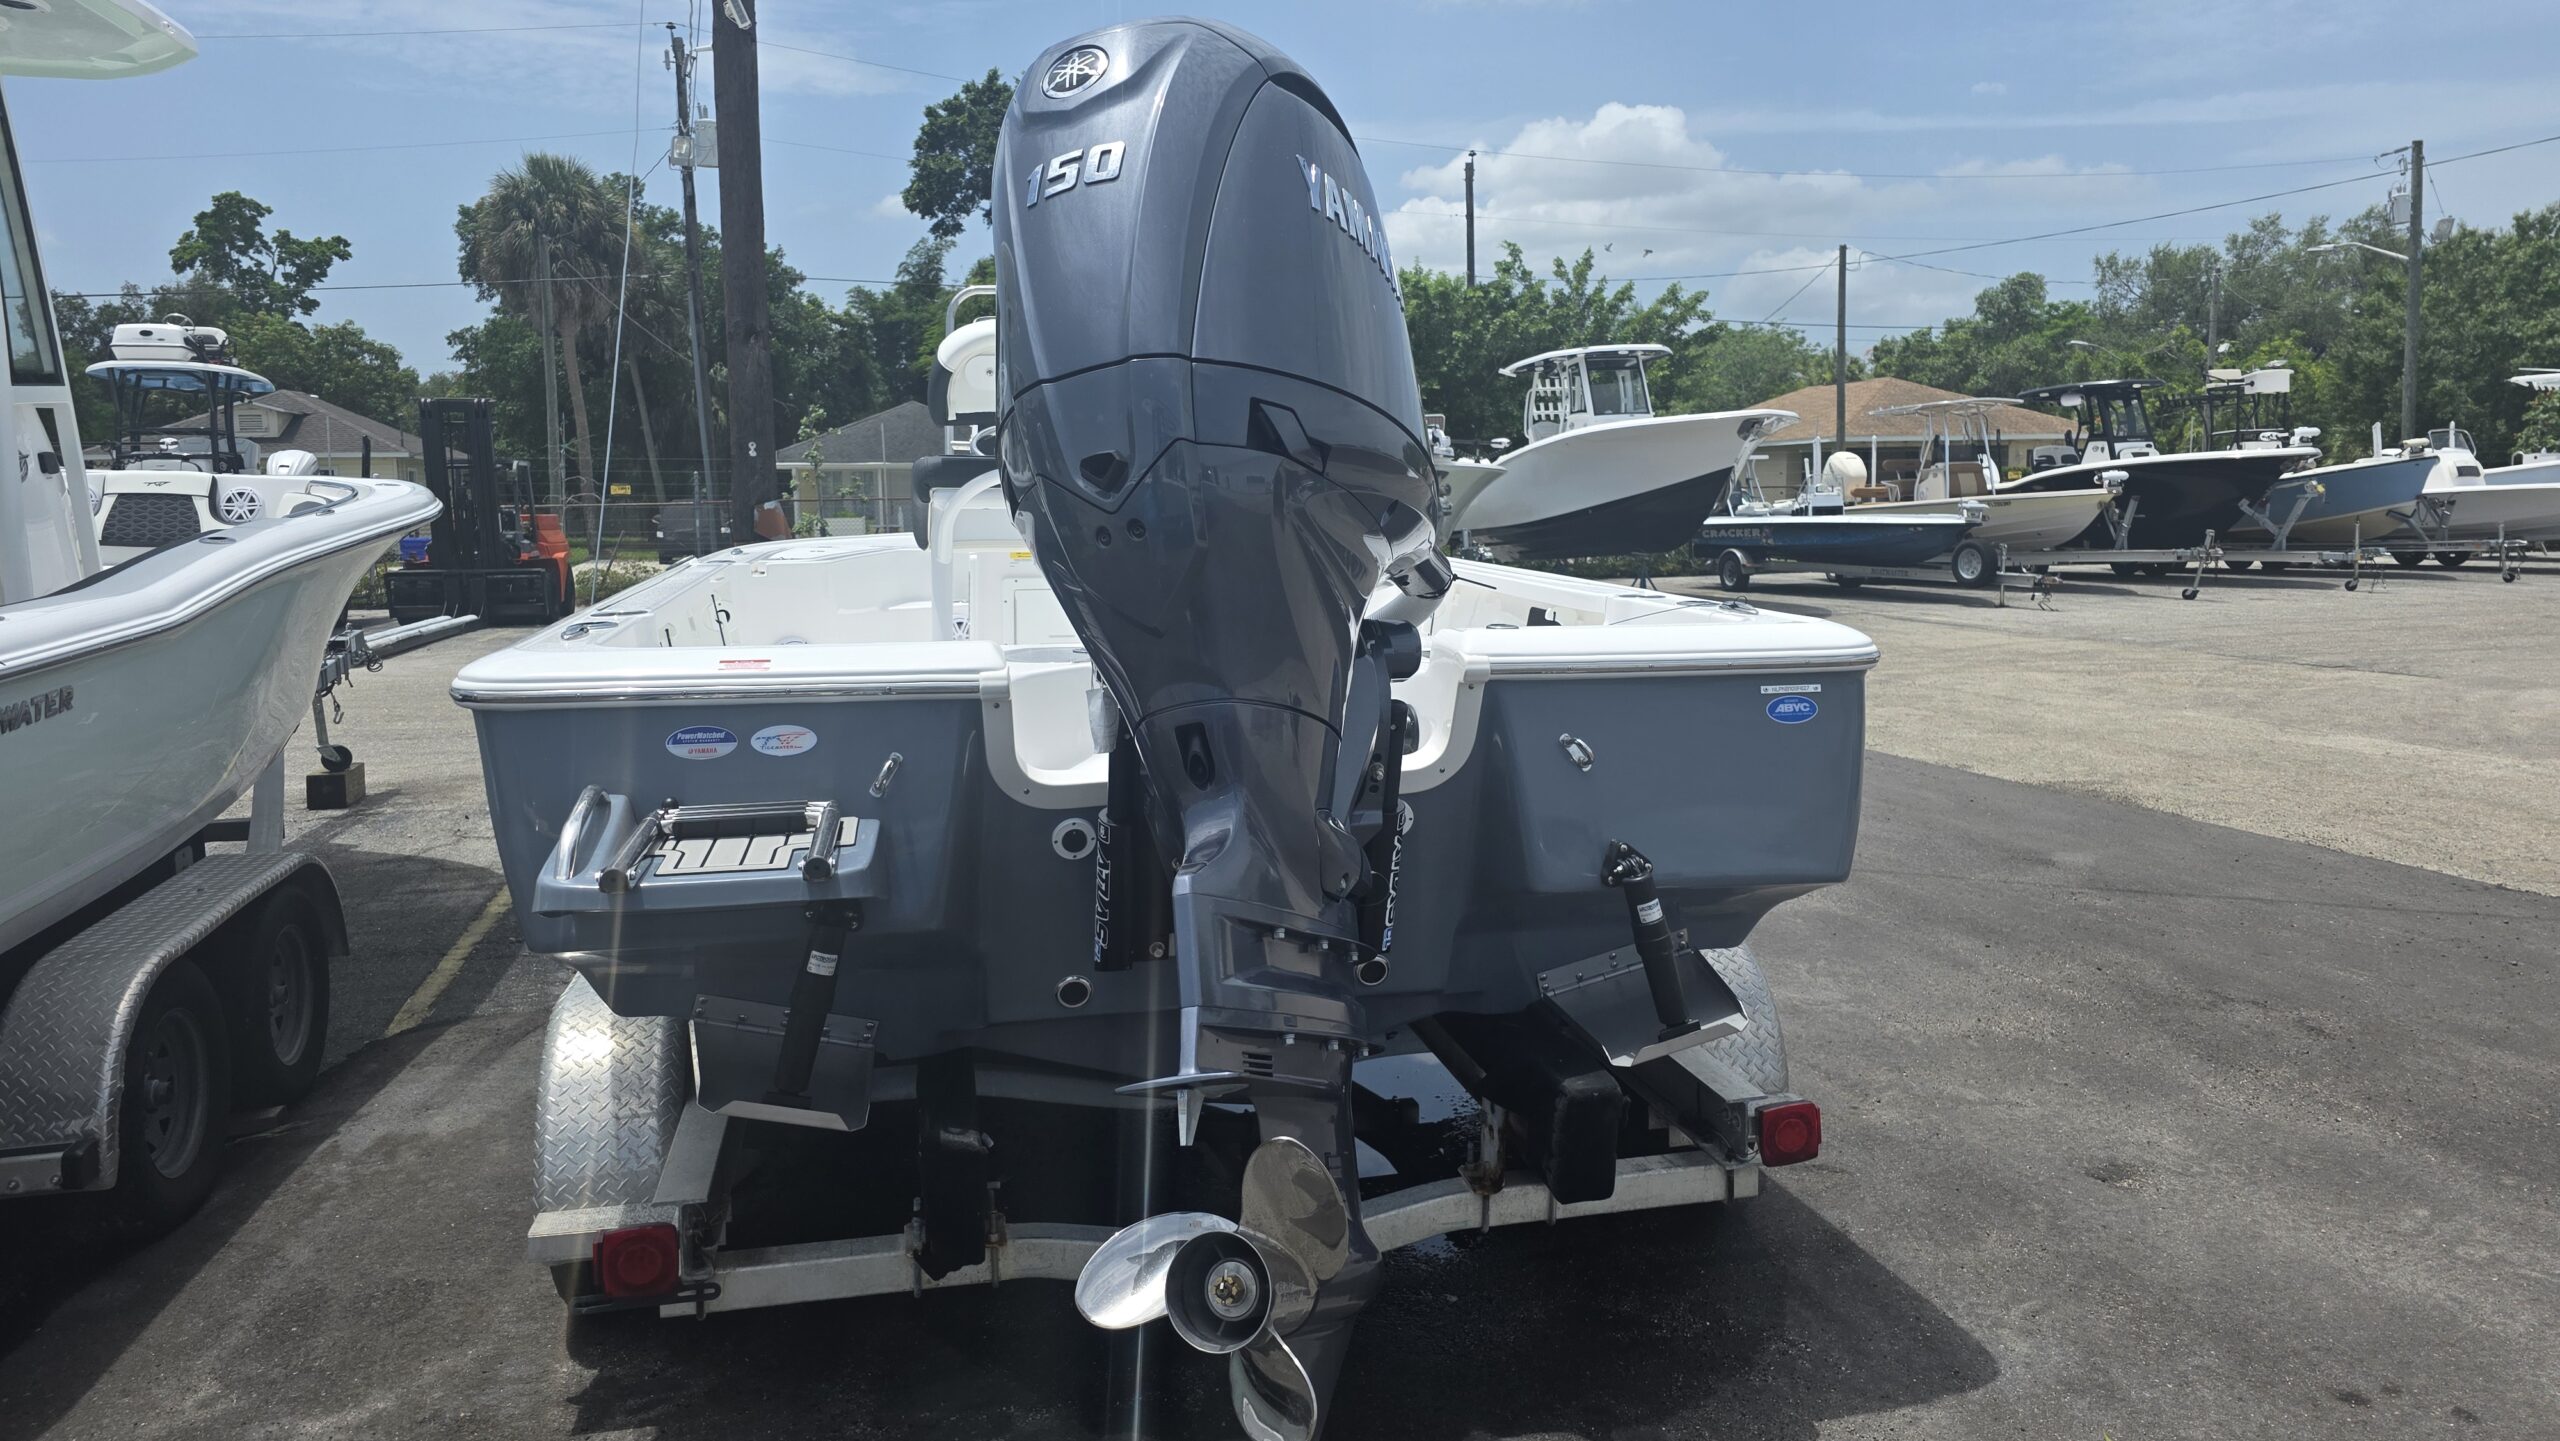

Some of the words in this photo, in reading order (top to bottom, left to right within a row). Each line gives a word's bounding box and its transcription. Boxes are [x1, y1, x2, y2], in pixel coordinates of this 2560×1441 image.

[1026, 140, 1127, 208] 150
[1701, 528, 1761, 539] CRACKER
[0, 685, 74, 735] WATER
[1774, 702, 1811, 713] ABYC
[676, 731, 726, 740] PowerMatched
[693, 747, 718, 755] YAMAHA
